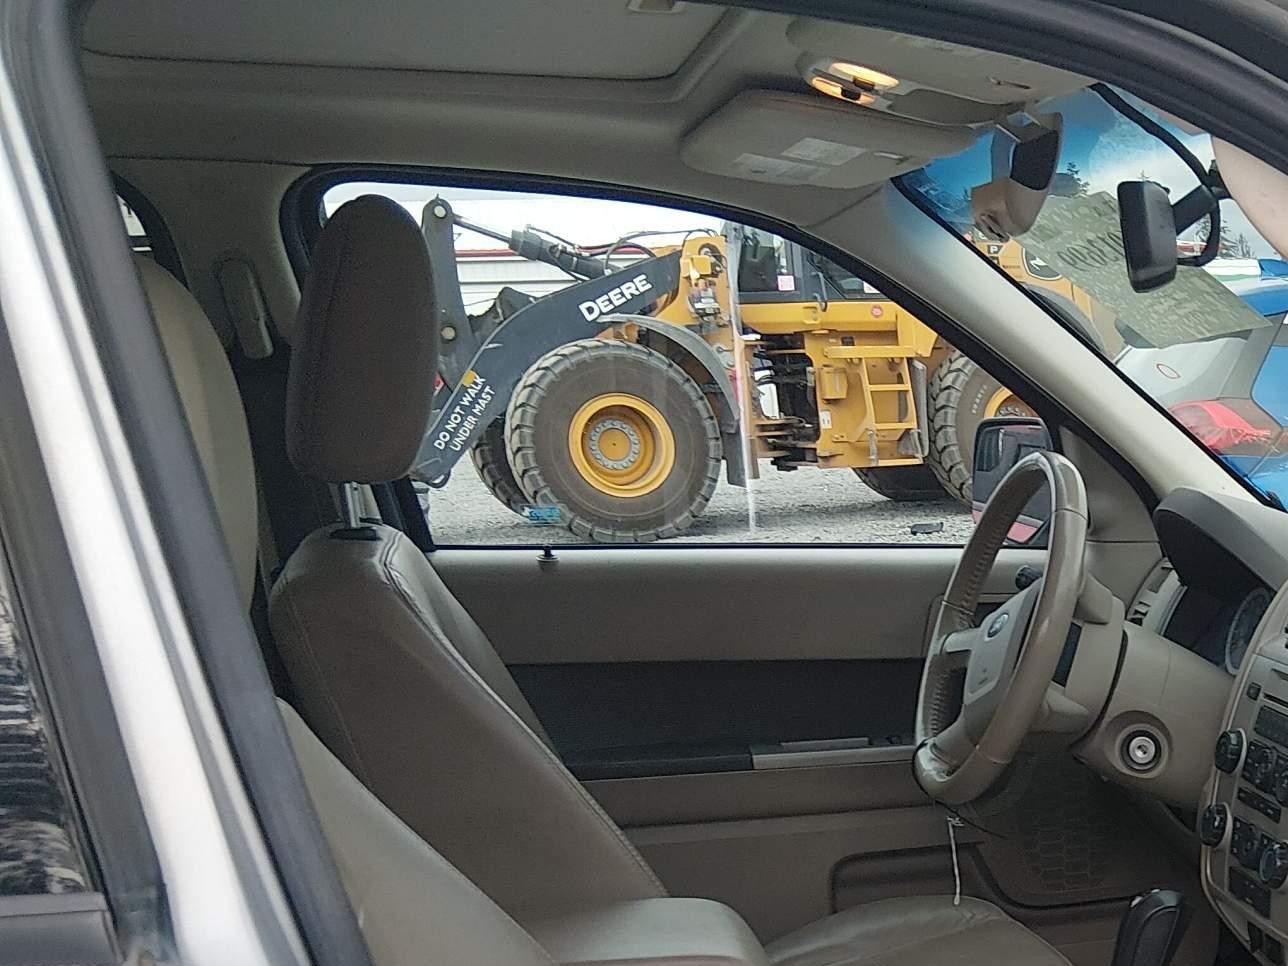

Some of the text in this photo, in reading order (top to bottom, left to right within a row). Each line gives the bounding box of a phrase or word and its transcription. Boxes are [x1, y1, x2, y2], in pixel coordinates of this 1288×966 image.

[578, 274, 653, 322] DEERE
[433, 374, 487, 450] DO NOT WALK
[449, 385, 496, 451] UNDER MAST
